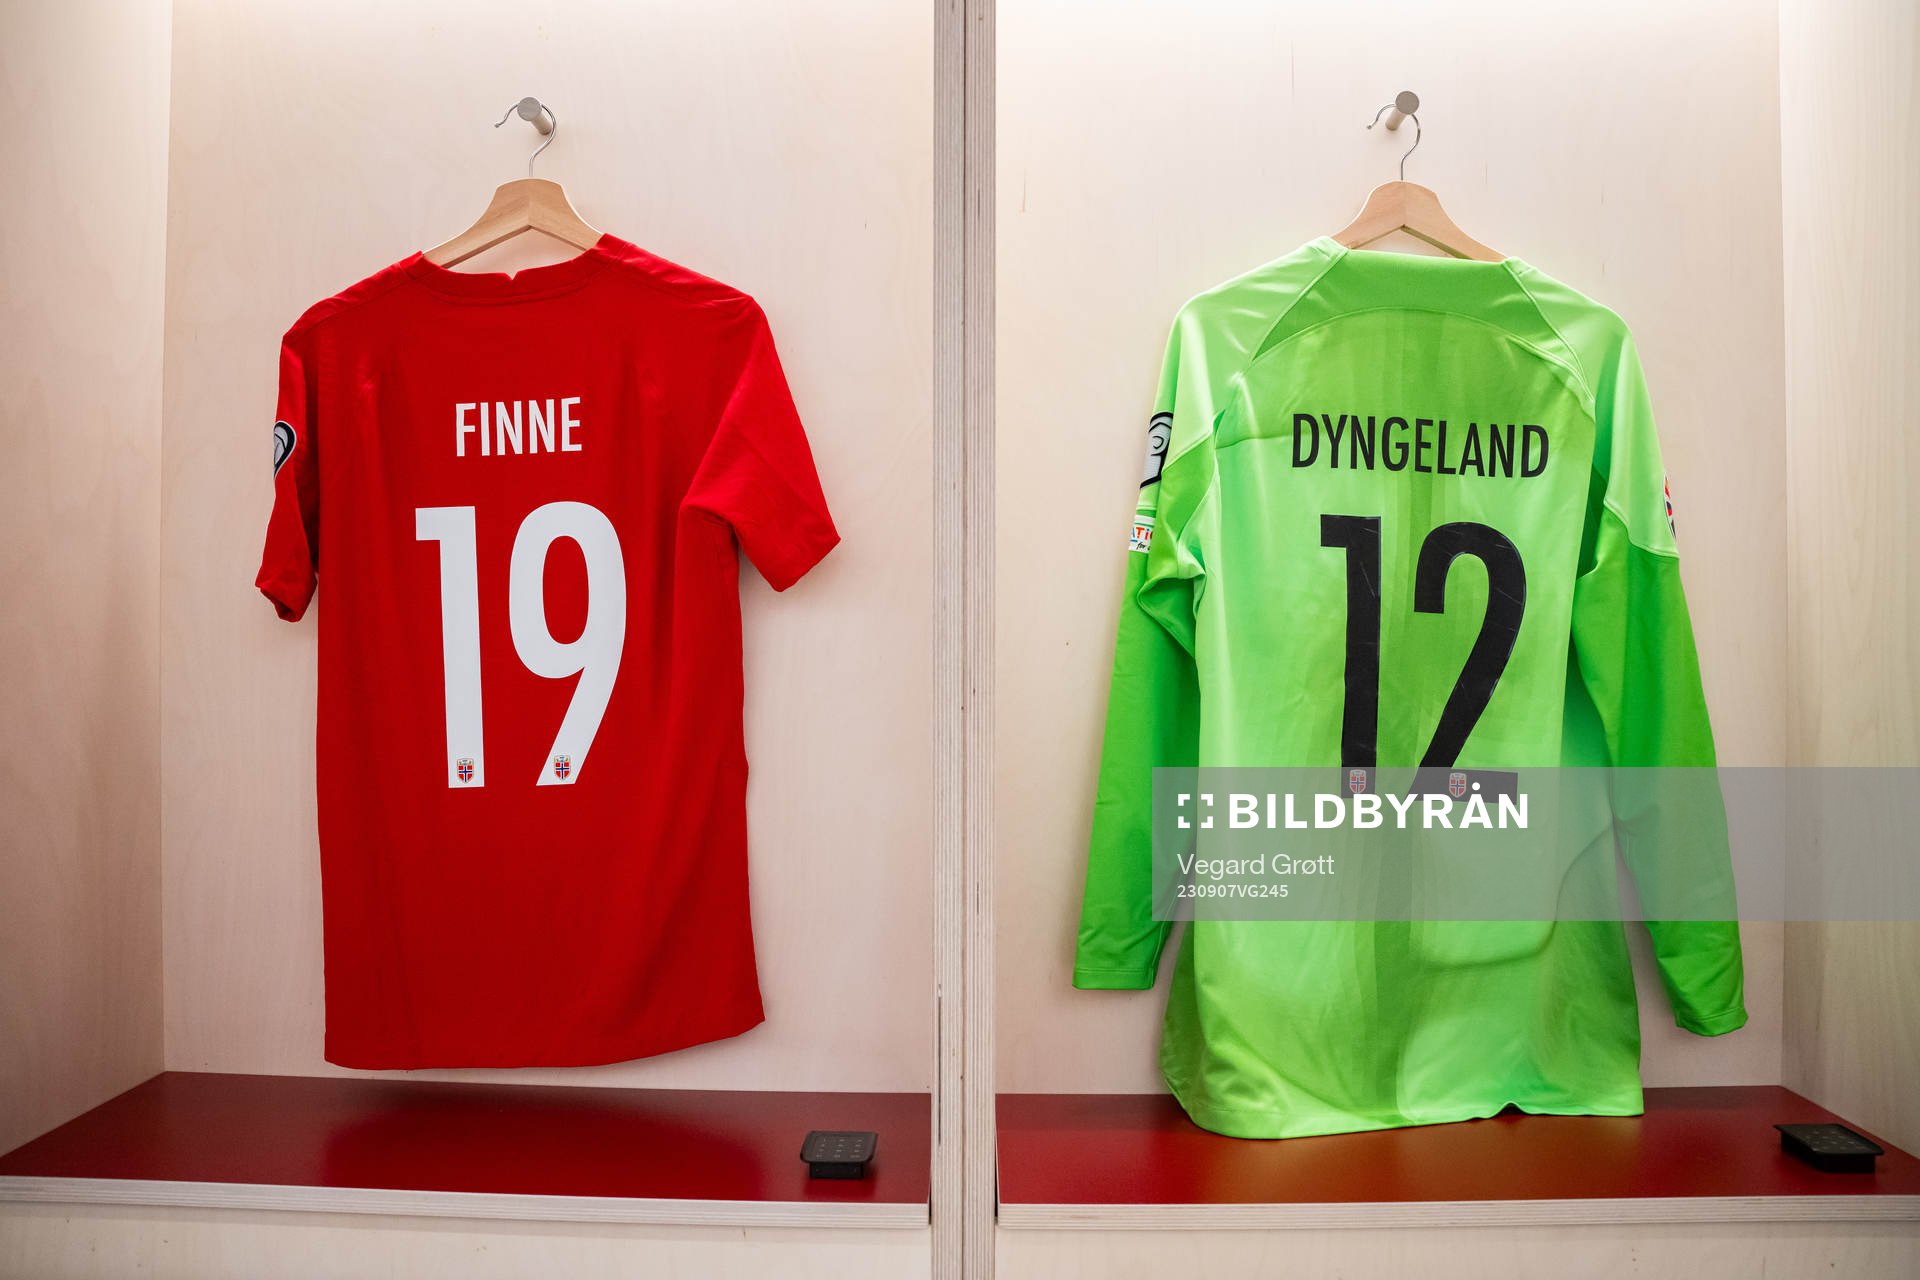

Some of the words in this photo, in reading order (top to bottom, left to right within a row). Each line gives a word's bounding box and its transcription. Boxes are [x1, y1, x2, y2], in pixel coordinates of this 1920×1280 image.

[455, 396, 582, 457] FINNE
[1292, 412, 1550, 479] DYNGELAND
[415, 501, 627, 789] 19
[1319, 513, 1527, 805] 12
